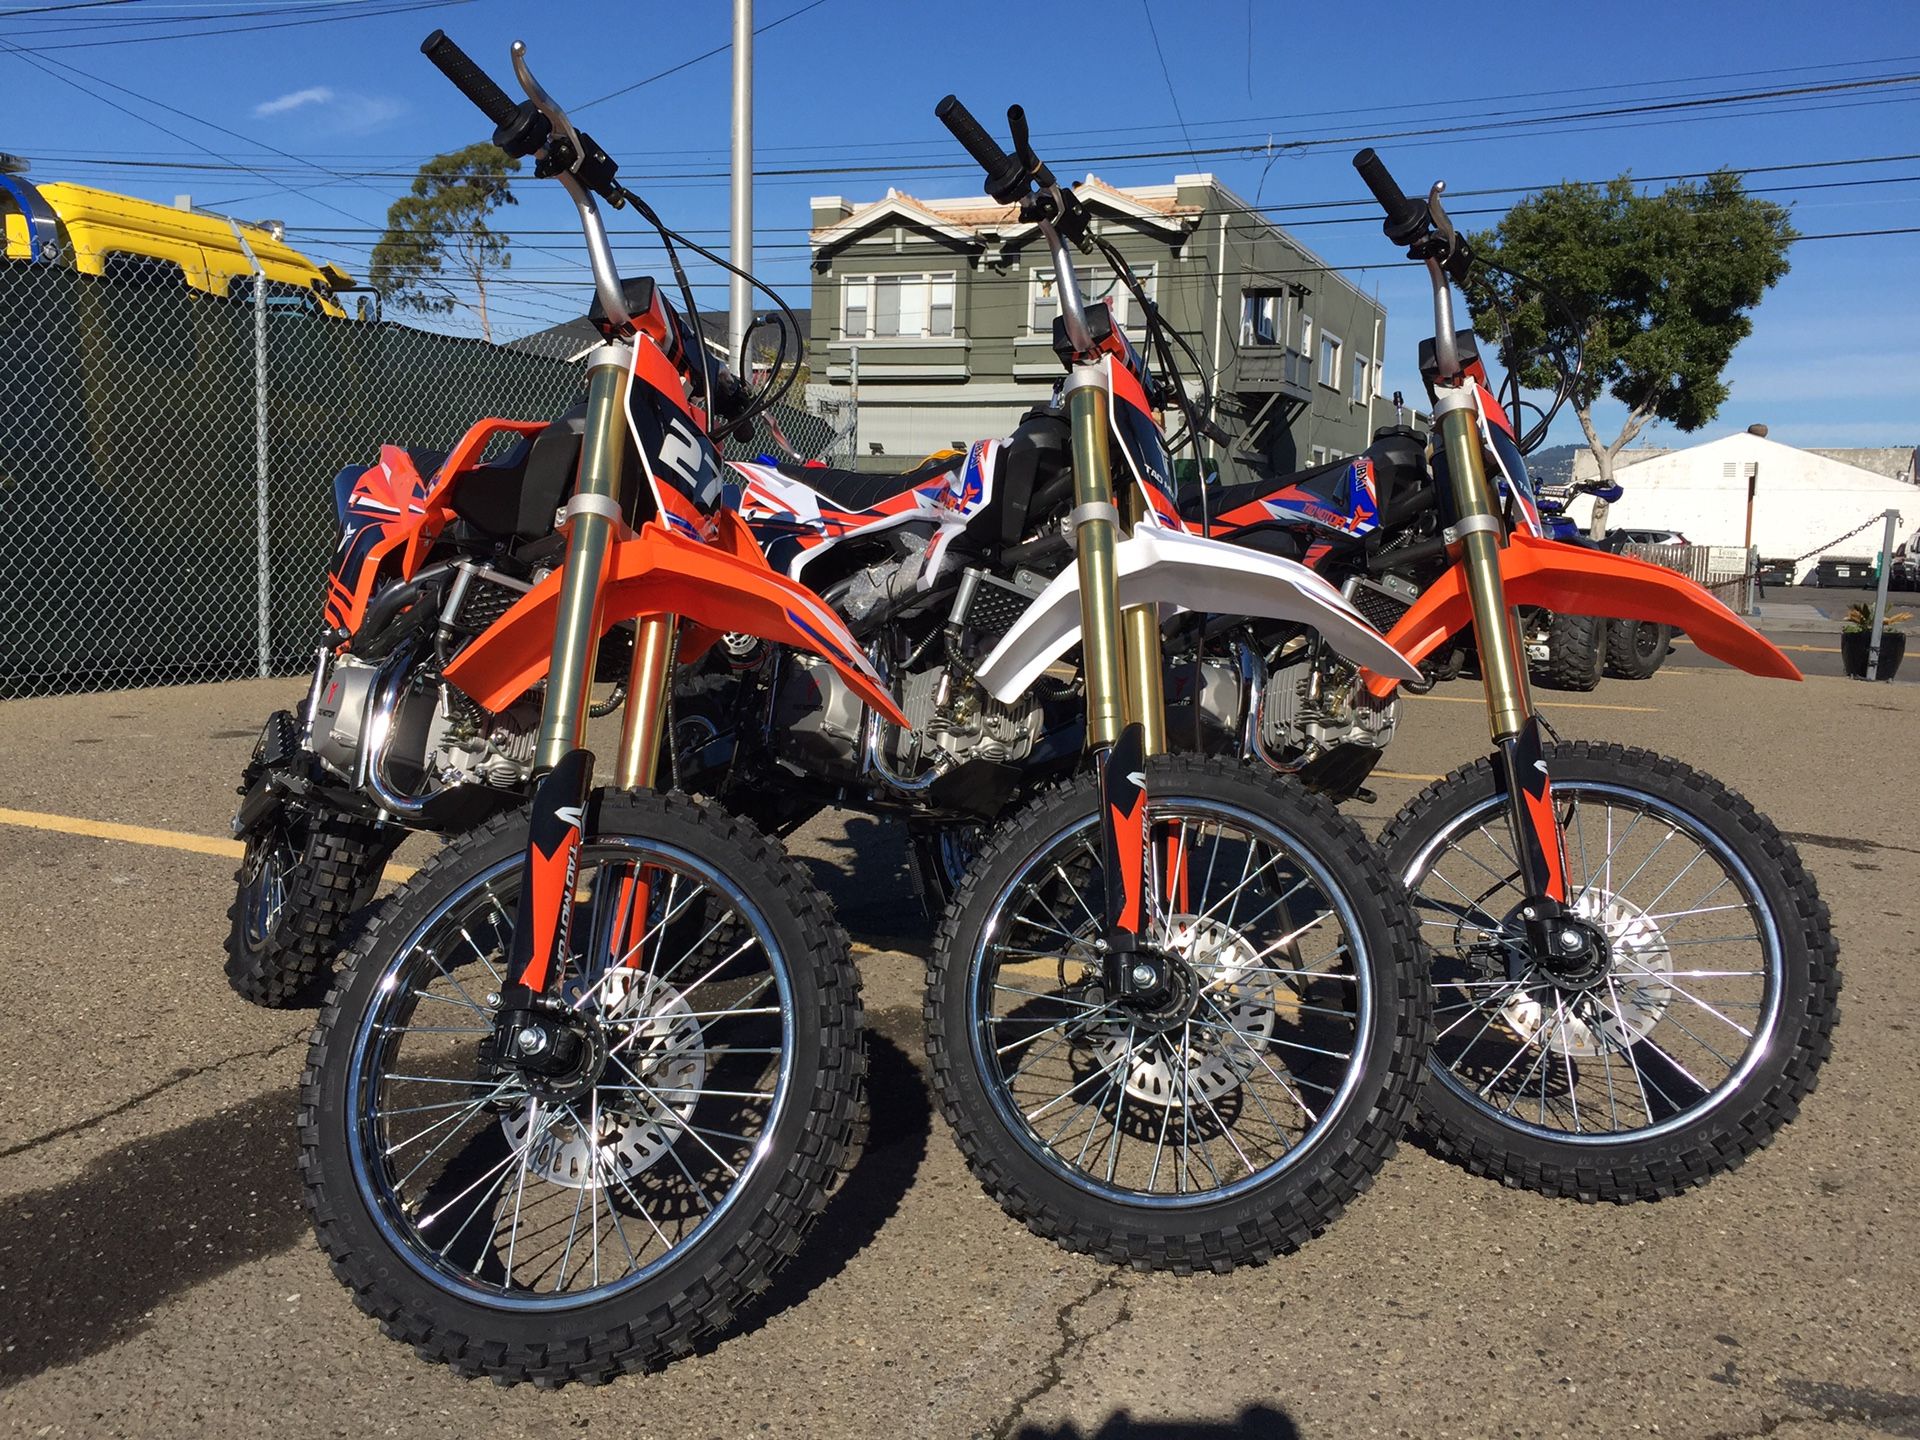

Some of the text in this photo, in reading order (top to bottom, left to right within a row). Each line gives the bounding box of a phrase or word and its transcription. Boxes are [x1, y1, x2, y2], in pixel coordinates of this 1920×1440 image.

[1144, 463, 1164, 484] TAO
[555, 844, 579, 974] TAO MOTOR
[1140, 804, 1152, 917] TAO MOTOR
